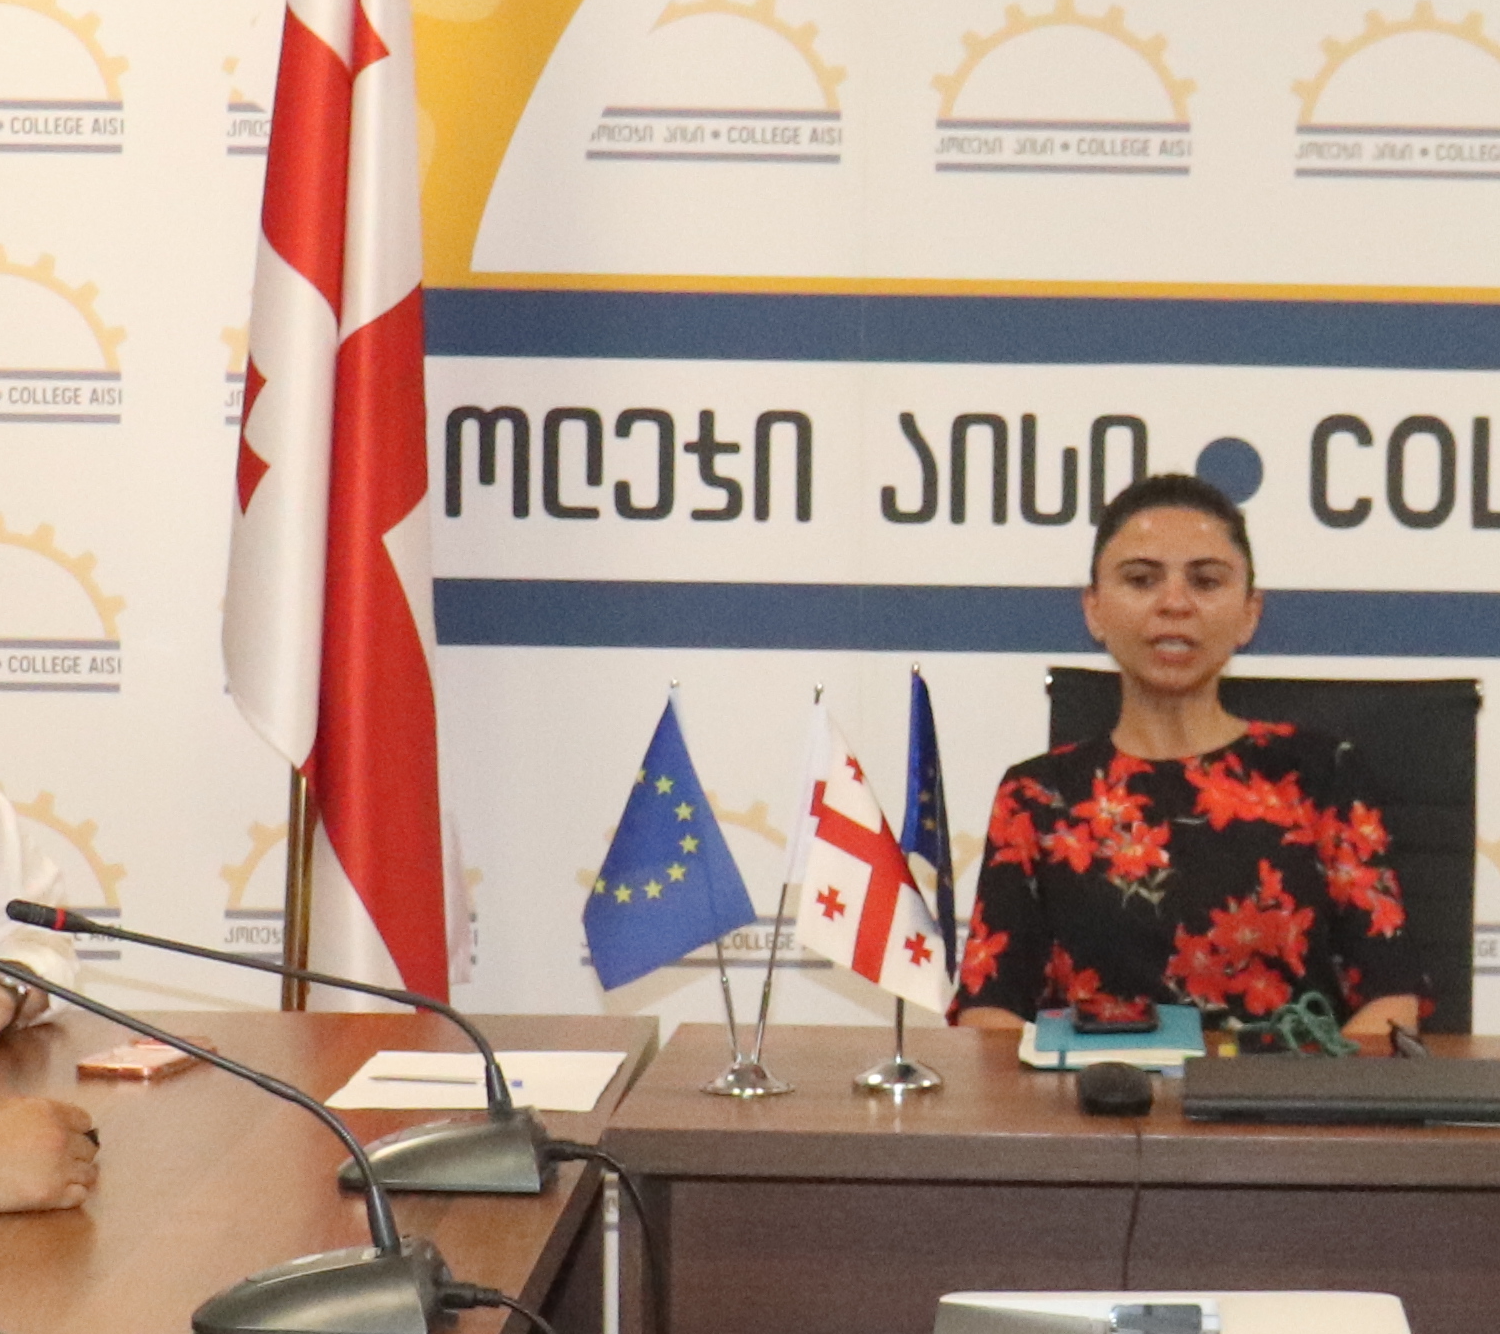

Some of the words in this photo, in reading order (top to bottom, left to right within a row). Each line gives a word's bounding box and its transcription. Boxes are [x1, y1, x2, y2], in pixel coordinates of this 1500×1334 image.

[10, 117, 85, 134] COLLEGE
[92, 117, 126, 134] AISI
[726, 126, 802, 144] COLLEGE
[808, 127, 843, 144] AISI
[1076, 138, 1151, 156] COLLEGE
[8, 387, 83, 404] COLLEGE
[90, 387, 124, 404] AISI
[445, 405, 812, 523] ოლეჯი
[7, 656, 82, 673] COLLEGE
[89, 656, 123, 673] AISI
